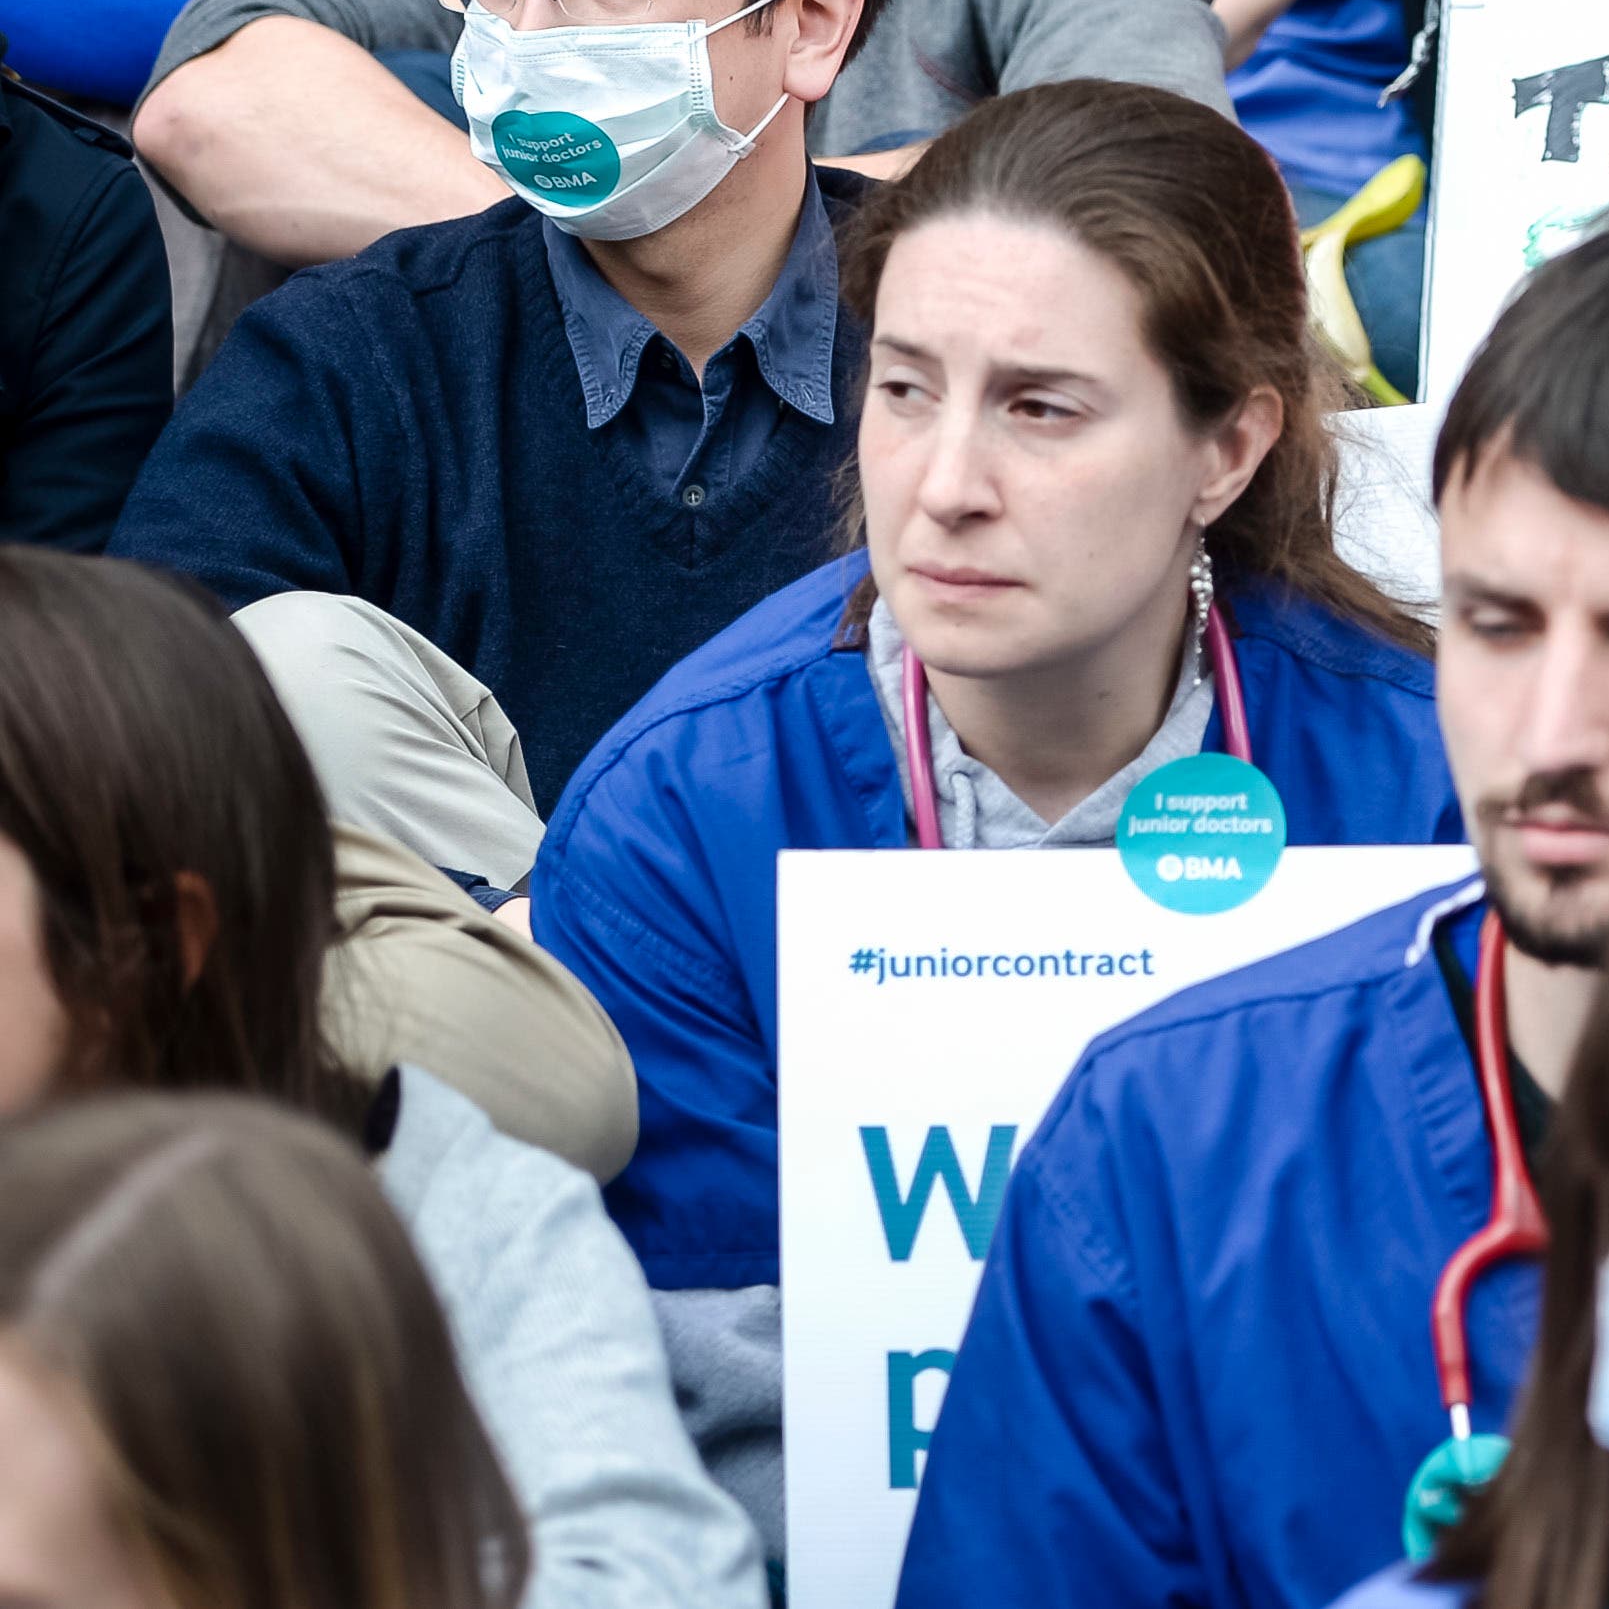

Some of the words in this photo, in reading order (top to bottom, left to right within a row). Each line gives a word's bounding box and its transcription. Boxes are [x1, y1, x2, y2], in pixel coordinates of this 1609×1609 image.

[500, 144, 540, 163] junior
[541, 138, 604, 163] doctors
[507, 132, 517, 144] I
[516, 132, 575, 152] support
[550, 171, 599, 190] BMA
[1154, 792, 1164, 810] I
[1166, 792, 1249, 815] support
[1127, 814, 1192, 838] junior
[1193, 814, 1274, 835] doctors
[1183, 855, 1244, 881] BMA
[848, 944, 1155, 986] #juniorcontract
